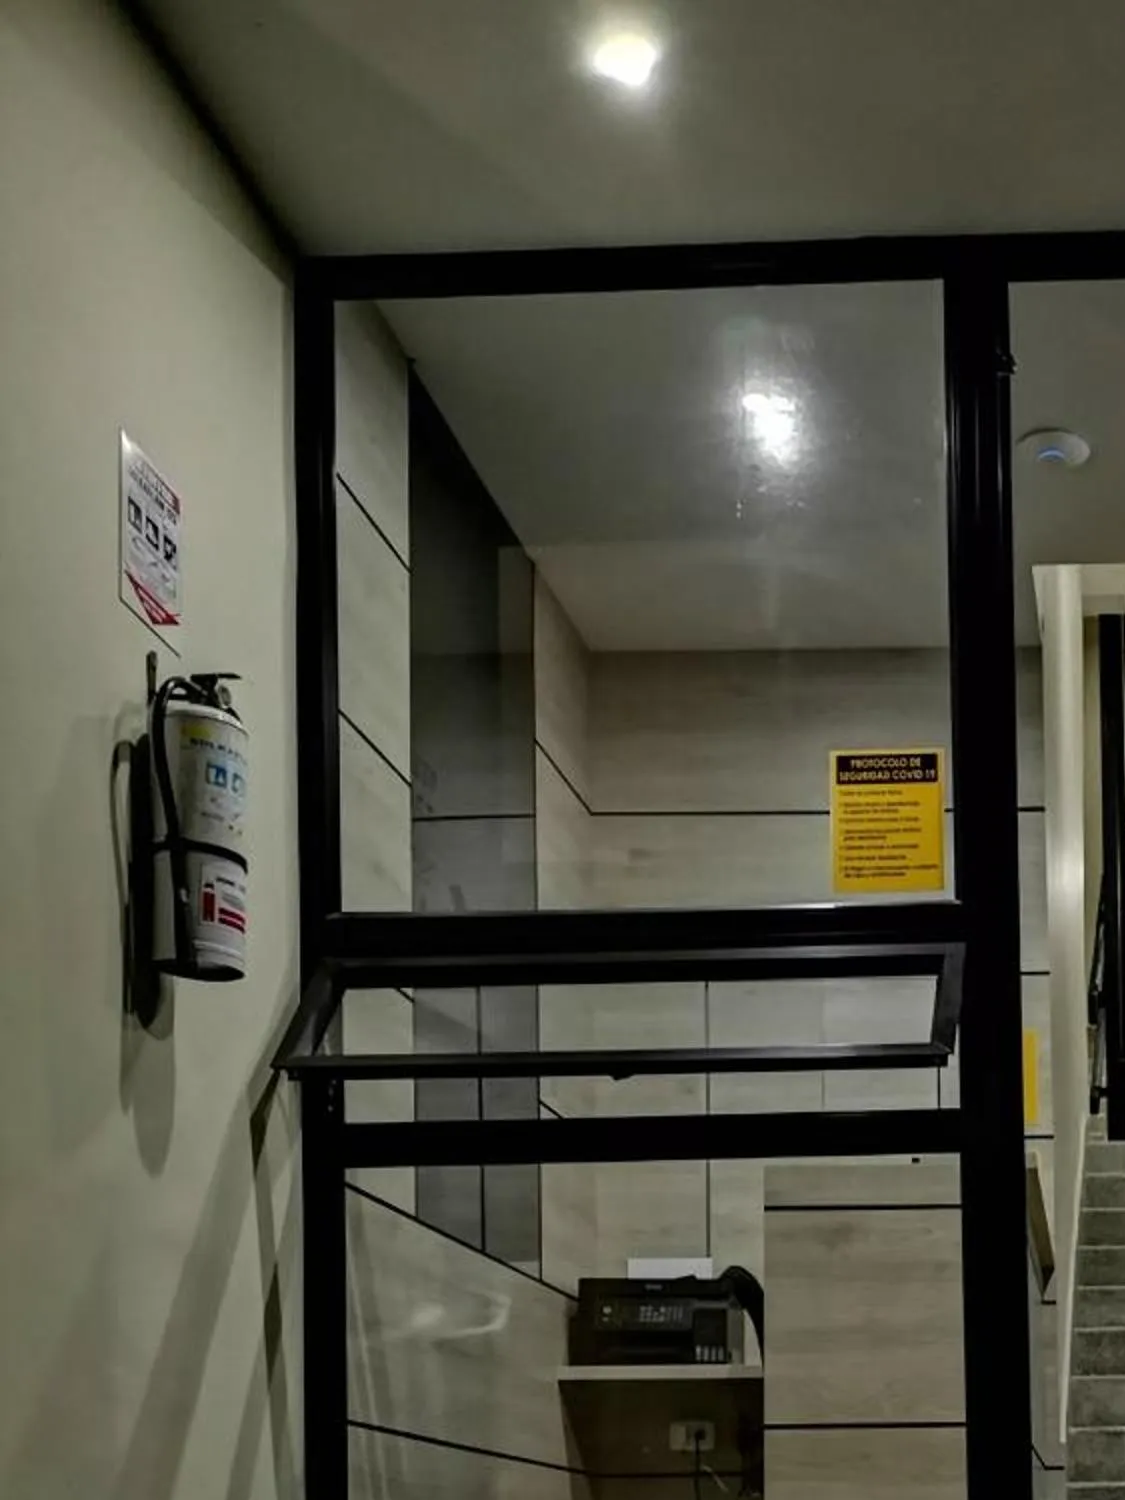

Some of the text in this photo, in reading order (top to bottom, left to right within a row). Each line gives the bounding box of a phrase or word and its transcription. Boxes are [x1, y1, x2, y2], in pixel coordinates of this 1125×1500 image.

[851, 757, 921, 769] PROTOCOLO DE
[839, 770, 890, 781] SEGURIDAD
[892, 768, 924, 780] COVID
